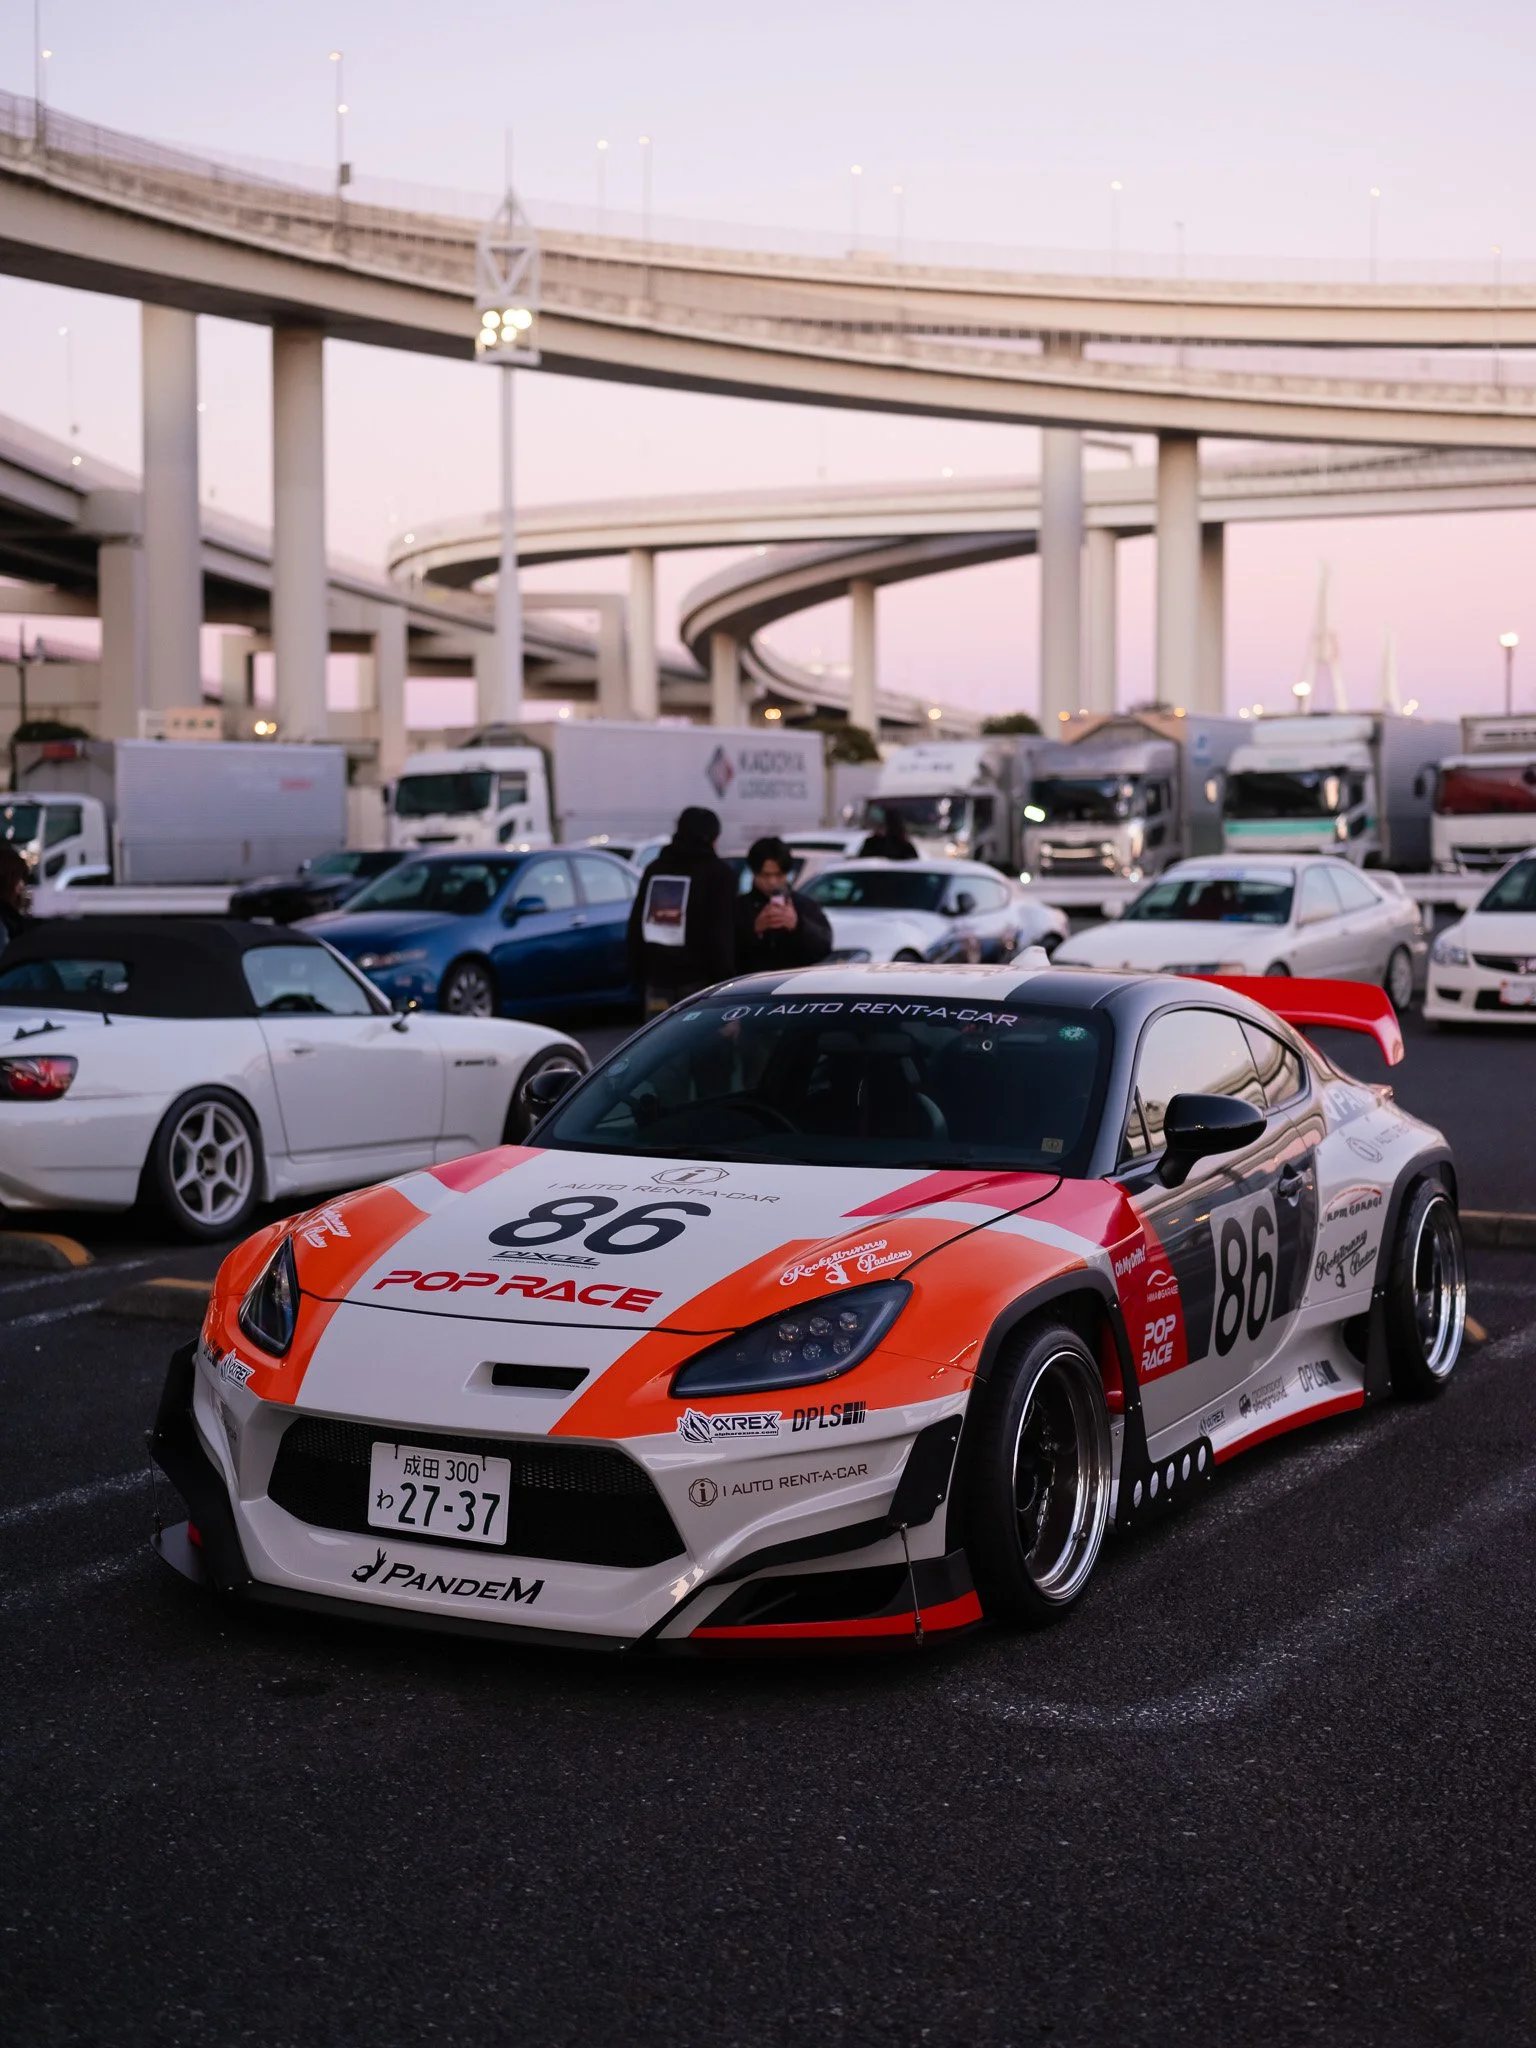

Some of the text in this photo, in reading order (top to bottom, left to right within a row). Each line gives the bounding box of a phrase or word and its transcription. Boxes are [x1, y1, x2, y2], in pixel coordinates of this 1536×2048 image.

[767, 1003, 844, 1015] AUTO
[850, 1002, 1018, 1027] RENT-A-CAR
[560, 1183, 628, 1191] AUTO
[632, 1185, 781, 1203] RENT-A-CAR
[488, 1195, 711, 1255] 86
[493, 1250, 600, 1266] DIXCEL
[857, 1249, 912, 1274] Pandem
[372, 1270, 664, 1313] POP RACE
[1215, 1205, 1275, 1357] 86
[1143, 1313, 1176, 1349] POP
[1140, 1340, 1174, 1373] RACE
[792, 1404, 842, 1432] DPLS
[403, 1455, 479, 1484] 成田 300
[732, 1479, 773, 1496] AUTO
[779, 1463, 868, 1488] RENT-A-CAR
[376, 1482, 500, 1535] わ 27-37
